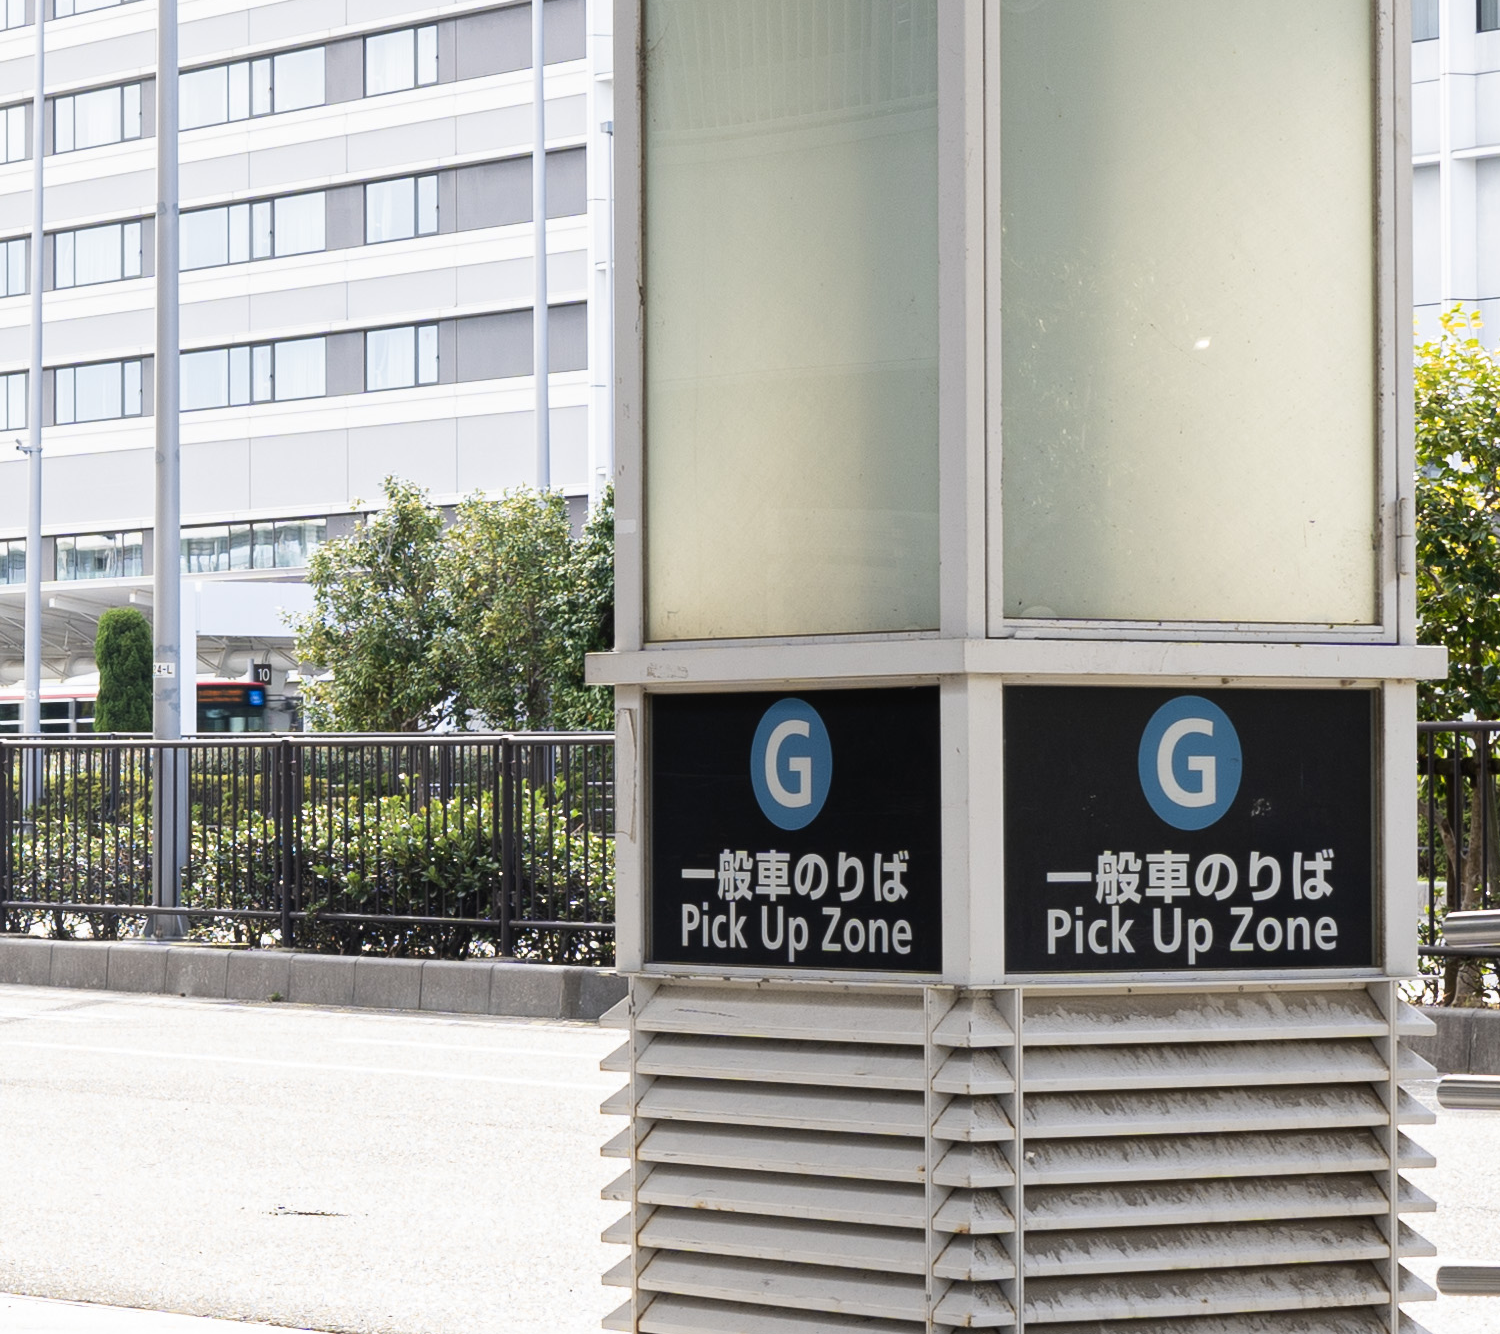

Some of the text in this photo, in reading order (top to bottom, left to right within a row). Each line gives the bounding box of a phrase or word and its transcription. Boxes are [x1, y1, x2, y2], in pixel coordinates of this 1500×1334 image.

[258, 668, 270, 681] 10
[764, 720, 812, 809] G
[1157, 718, 1217, 808] G
[681, 849, 910, 901] 一般車のりば
[1046, 850, 1335, 904] 一般車のりば
[681, 902, 913, 964] Pick Up Zone
[1047, 905, 1339, 965] Pick Up Zone
